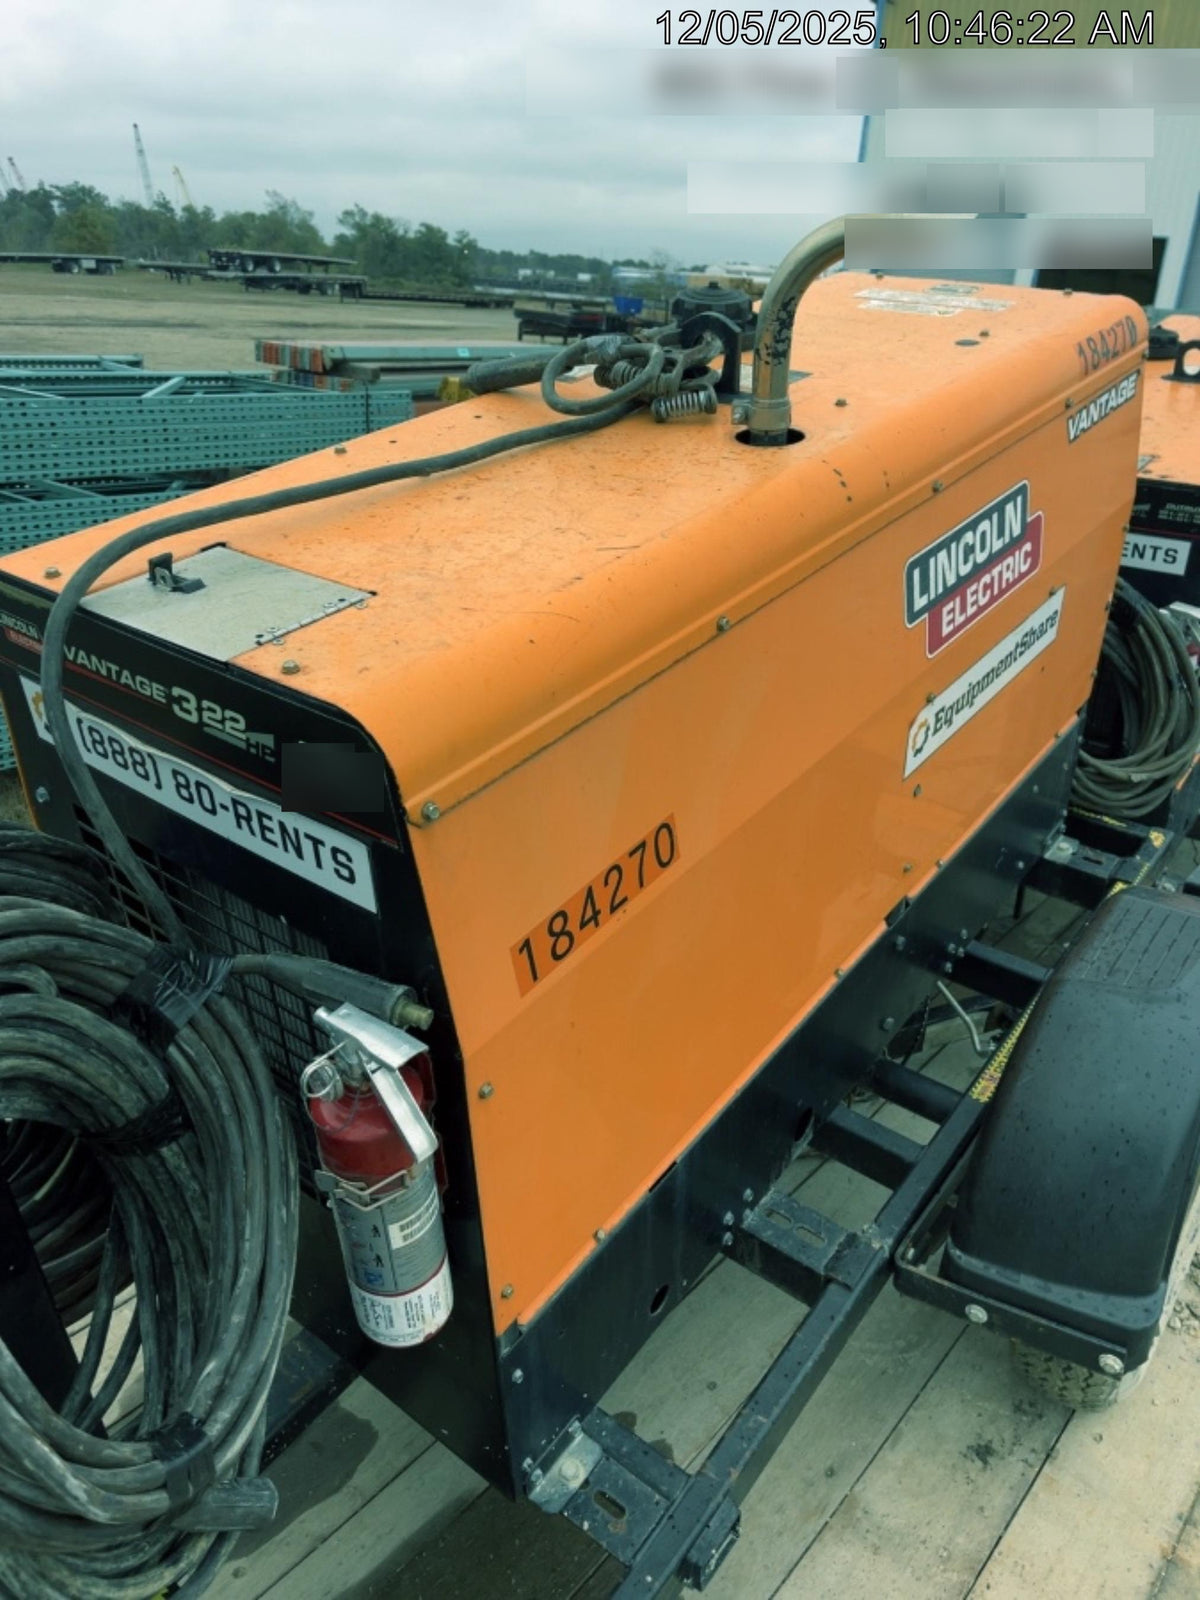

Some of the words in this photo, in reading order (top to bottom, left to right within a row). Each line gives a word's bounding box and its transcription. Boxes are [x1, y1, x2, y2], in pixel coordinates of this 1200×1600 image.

[1077, 315, 1138, 377] 184270
[1067, 373, 1138, 441] VANTAGE
[912, 493, 1023, 613] LINCOLN
[941, 541, 1033, 638] ELECTRIC
[63, 644, 168, 705] VANTAGE
[170, 686, 246, 735] 322
[930, 608, 1060, 737] EquipmentShare
[75, 717, 163, 791] (888)
[173, 762, 358, 886] 80-RENTS
[517, 821, 677, 984] 184270
